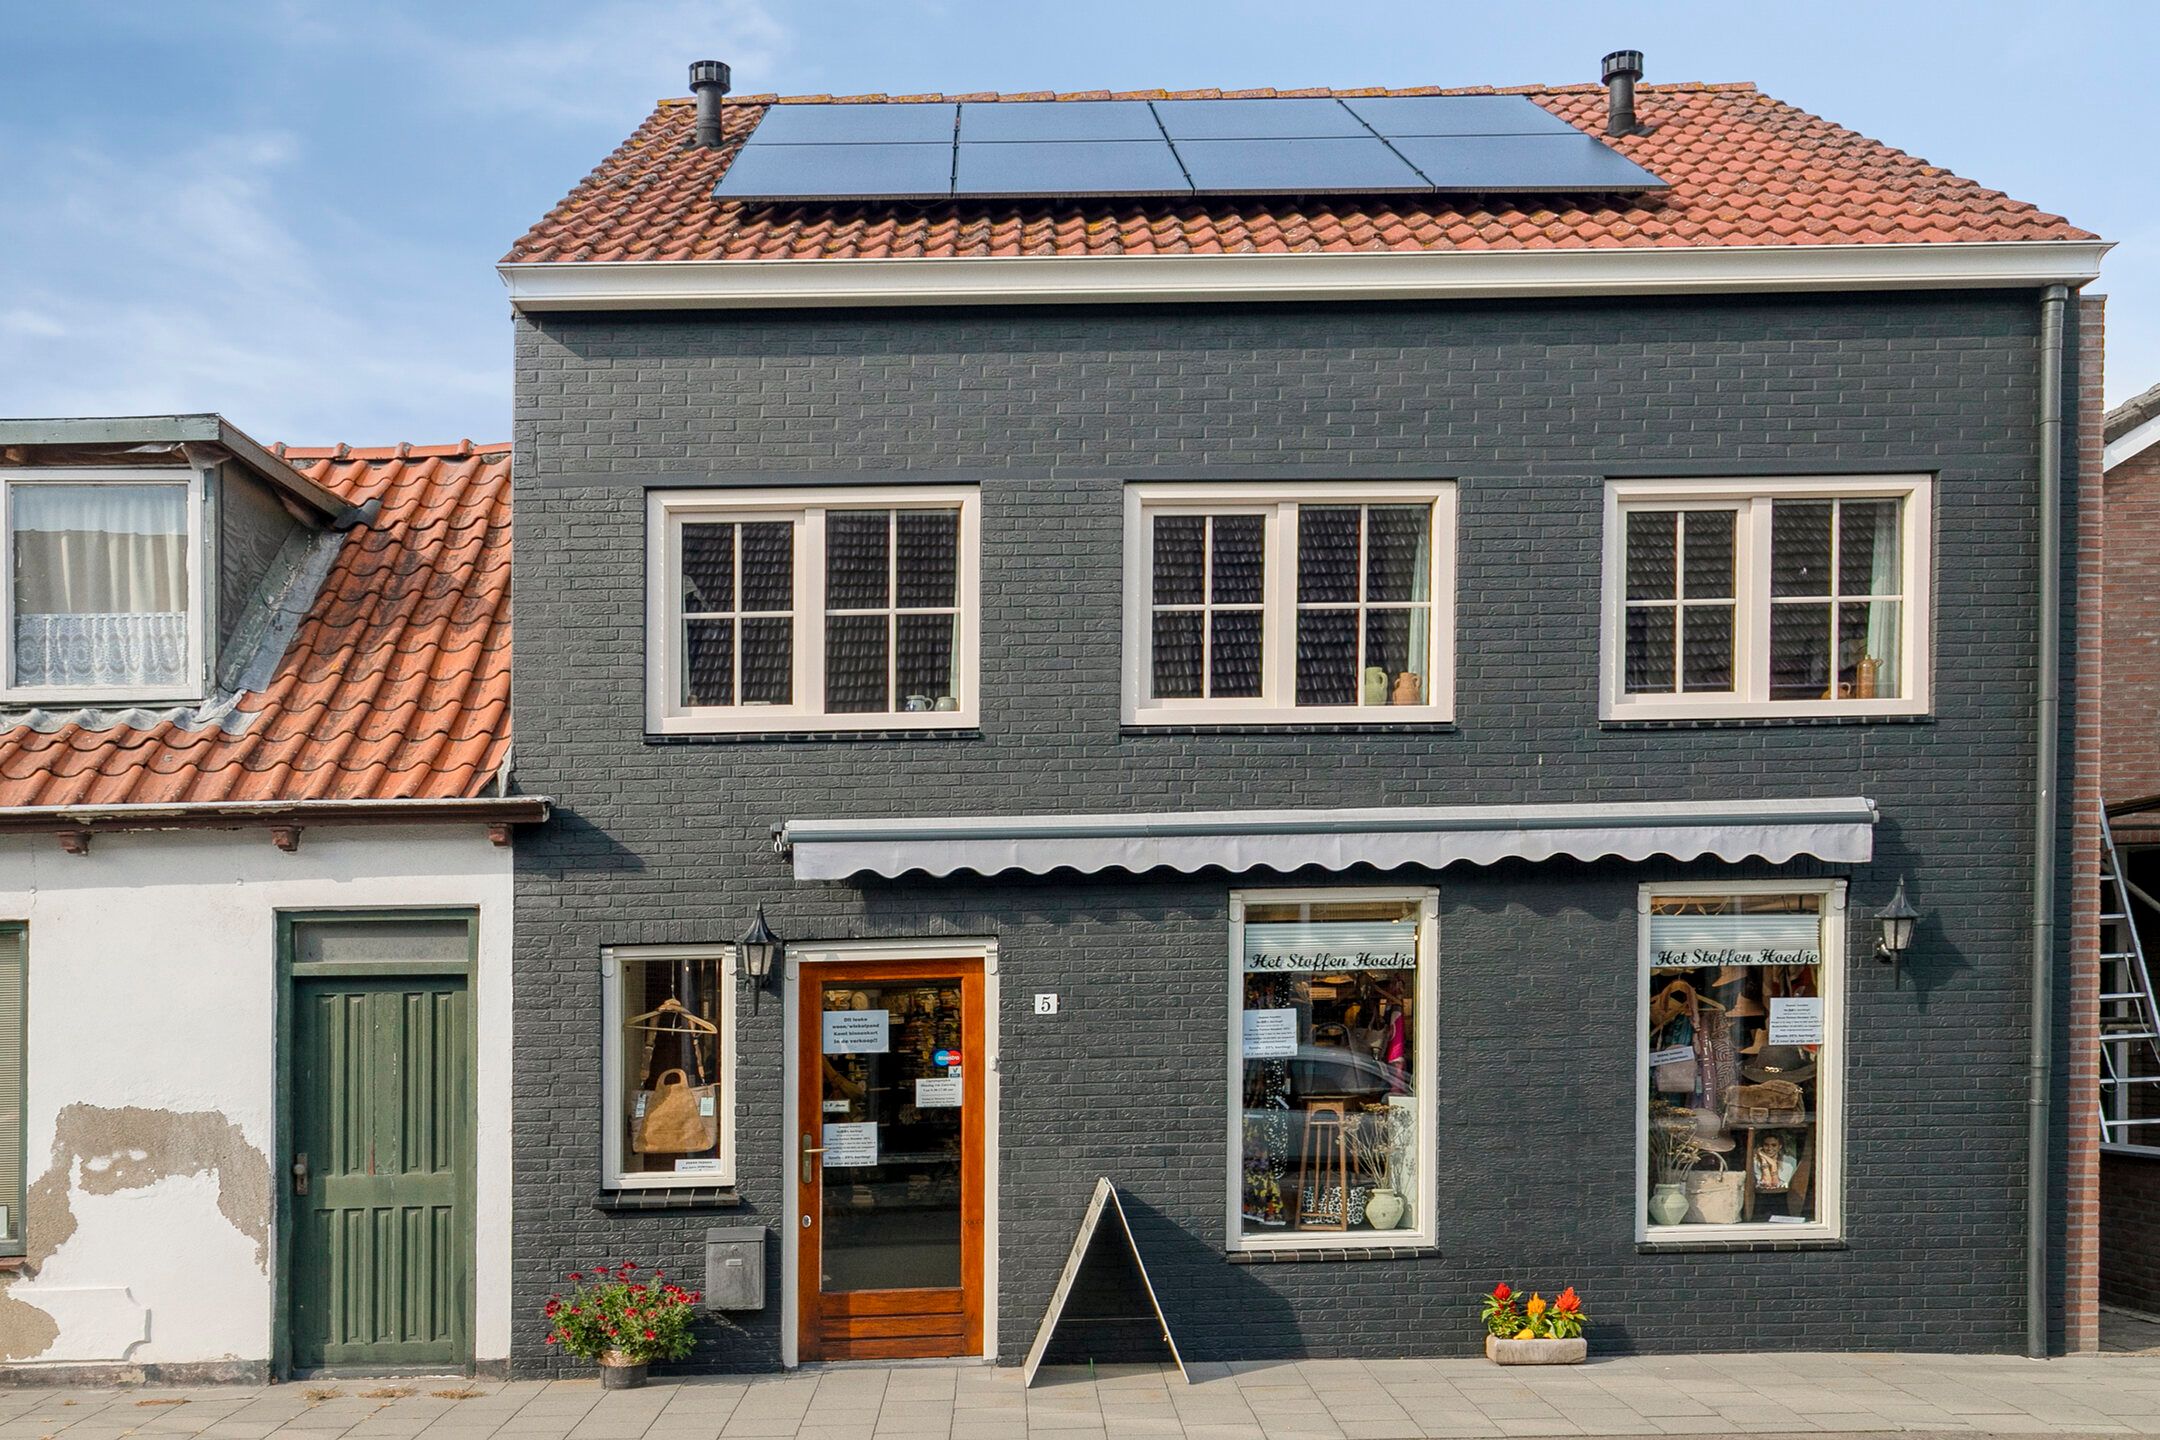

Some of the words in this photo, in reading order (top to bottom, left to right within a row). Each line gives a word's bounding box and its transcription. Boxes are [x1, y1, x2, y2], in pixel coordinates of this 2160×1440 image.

[1249, 953, 1281, 969] Het
[1287, 952, 1348, 971] Stoffen
[1353, 952, 1414, 969] Hoedje
[1656, 950, 1687, 966] Het
[1691, 948, 1753, 967] Stoffen
[1757, 948, 1818, 966] Hoedje
[1041, 996, 1051, 1012] 5
